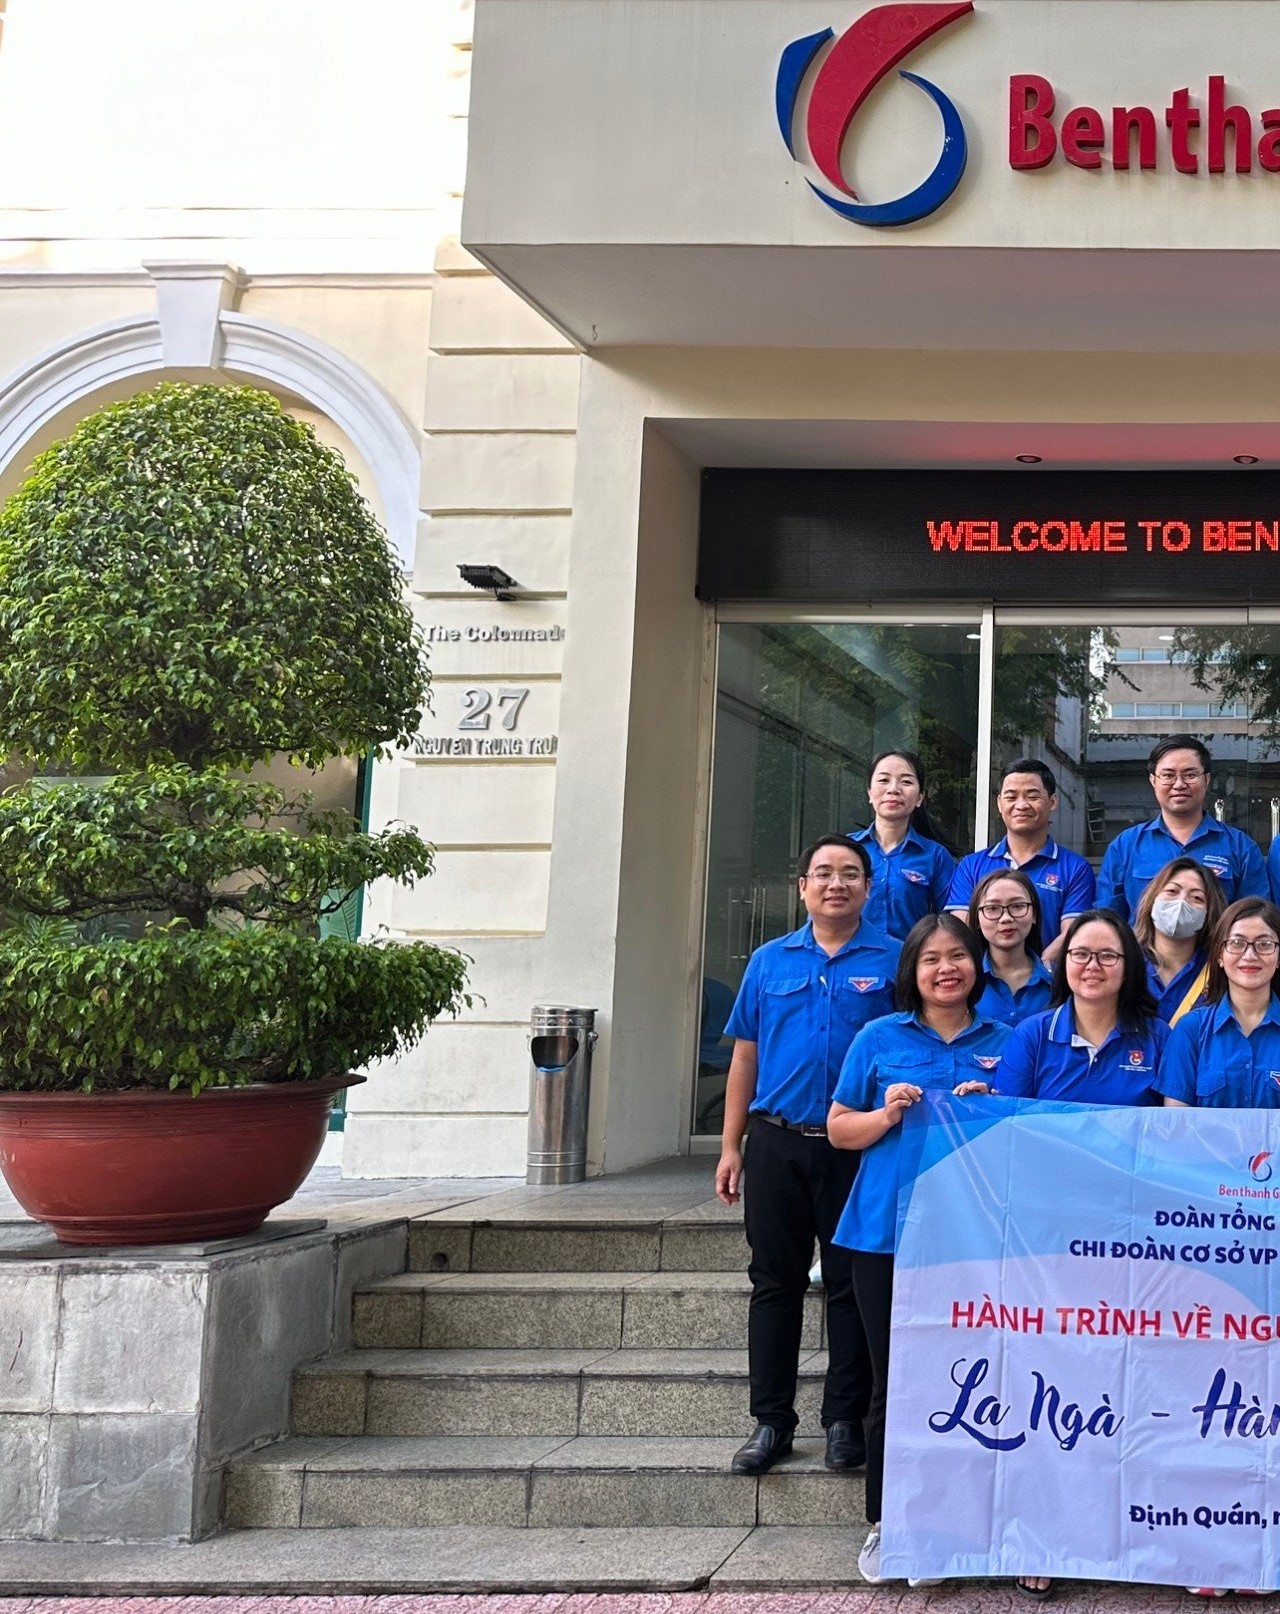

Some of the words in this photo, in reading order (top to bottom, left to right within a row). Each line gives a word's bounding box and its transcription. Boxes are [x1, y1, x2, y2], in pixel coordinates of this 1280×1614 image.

[926, 520, 1128, 552] WELCOME
[1137, 521, 1191, 552] TO
[424, 625, 461, 642] The
[458, 687, 530, 732] 27
[475, 737, 523, 755] TRUNG
[1218, 1184, 1271, 1200] Benthanh
[1154, 1204, 1215, 1229] ĐOÀN
[1219, 1202, 1276, 1231] TỔNG
[1069, 1239, 1106, 1258] CHI
[1109, 1235, 1175, 1261] ĐOÀN
[1180, 1244, 1211, 1263] CƠ
[1214, 1239, 1245, 1264] SỞ
[1248, 1248, 1278, 1265] VP
[951, 1293, 1044, 1333] HÀNH
[1057, 1301, 1162, 1336] TRÌNH
[1173, 1302, 1211, 1340] VỀ
[928, 1357, 1026, 1452] La
[1030, 1371, 1125, 1451] Ngà
[1128, 1504, 1188, 1531] Định
[1193, 1501, 1268, 1529] Quán,
